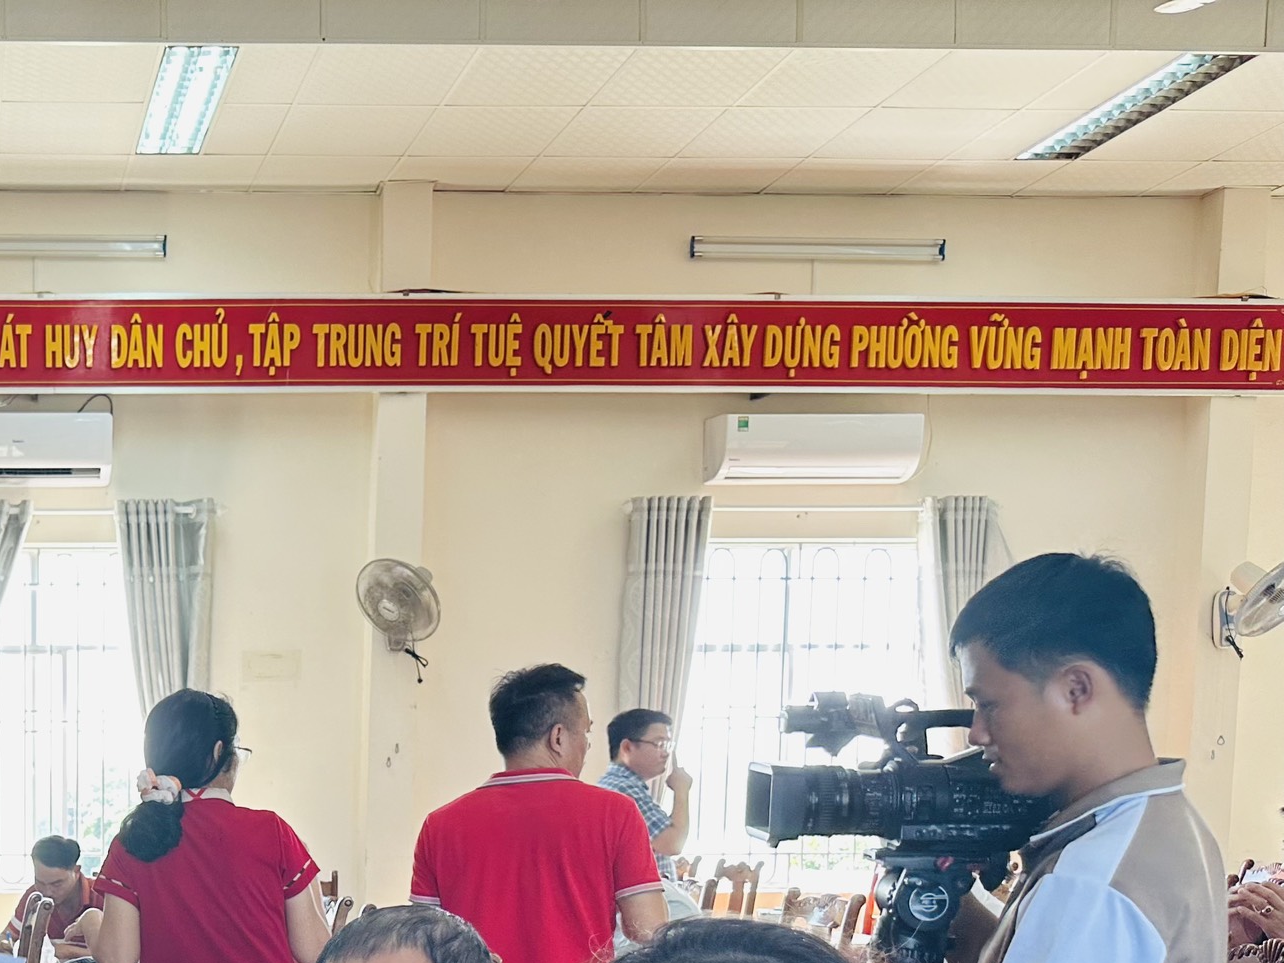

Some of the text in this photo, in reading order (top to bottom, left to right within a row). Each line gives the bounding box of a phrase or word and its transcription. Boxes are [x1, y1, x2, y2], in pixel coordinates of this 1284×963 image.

[44, 323, 98, 368] HUY
[111, 313, 164, 368] DÂN
[248, 312, 301, 376] TẬP
[313, 322, 402, 368] TRUNG
[415, 312, 462, 367] TRÍ
[471, 313, 523, 376] TUỆ
[533, 313, 624, 374] QUYẾT
[635, 313, 693, 367] TÂM
[702, 313, 756, 368] XÂY
[763, 317, 841, 377] DỰNG
[849, 312, 959, 370] PHƯỜNG
[969, 313, 1042, 370] VỮNG
[1050, 327, 1132, 379] MẠNH
[1140, 318, 1211, 371] TOÀN
[1219, 318, 1283, 381] DIỆN
